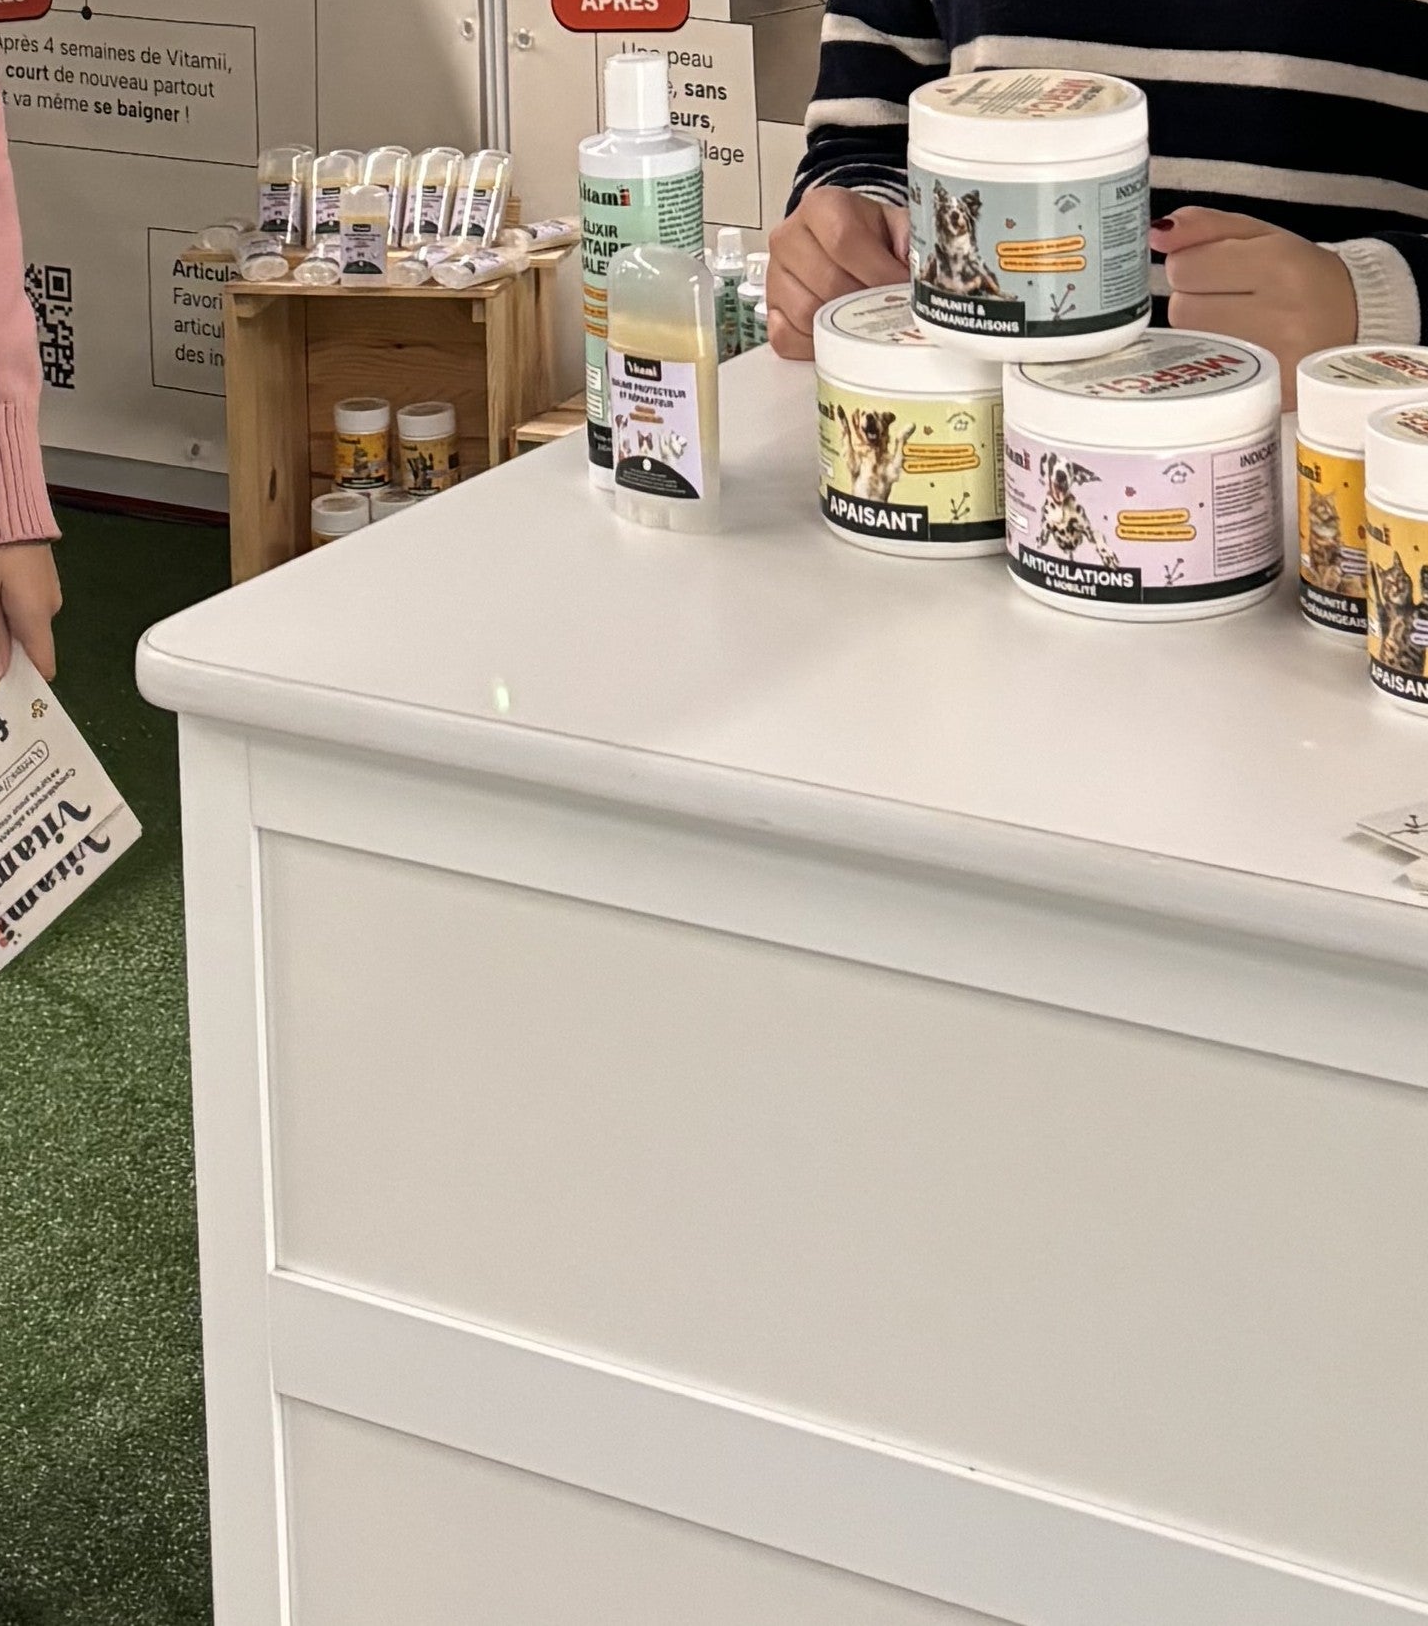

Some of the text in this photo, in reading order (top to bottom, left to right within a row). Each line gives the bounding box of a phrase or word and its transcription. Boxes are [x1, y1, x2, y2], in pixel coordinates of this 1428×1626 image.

[43, 36, 55, 54] 4
[59, 42, 136, 63] semaines
[140, 46, 162, 65] de
[166, 48, 232, 75] Vitamii,
[5, 64, 215, 99] court de nouveau partout
[12, 92, 181, 124] va même se baigner
[830, 496, 922, 532] APAISANT
[1023, 552, 1133, 587] ARTICULATIONS
